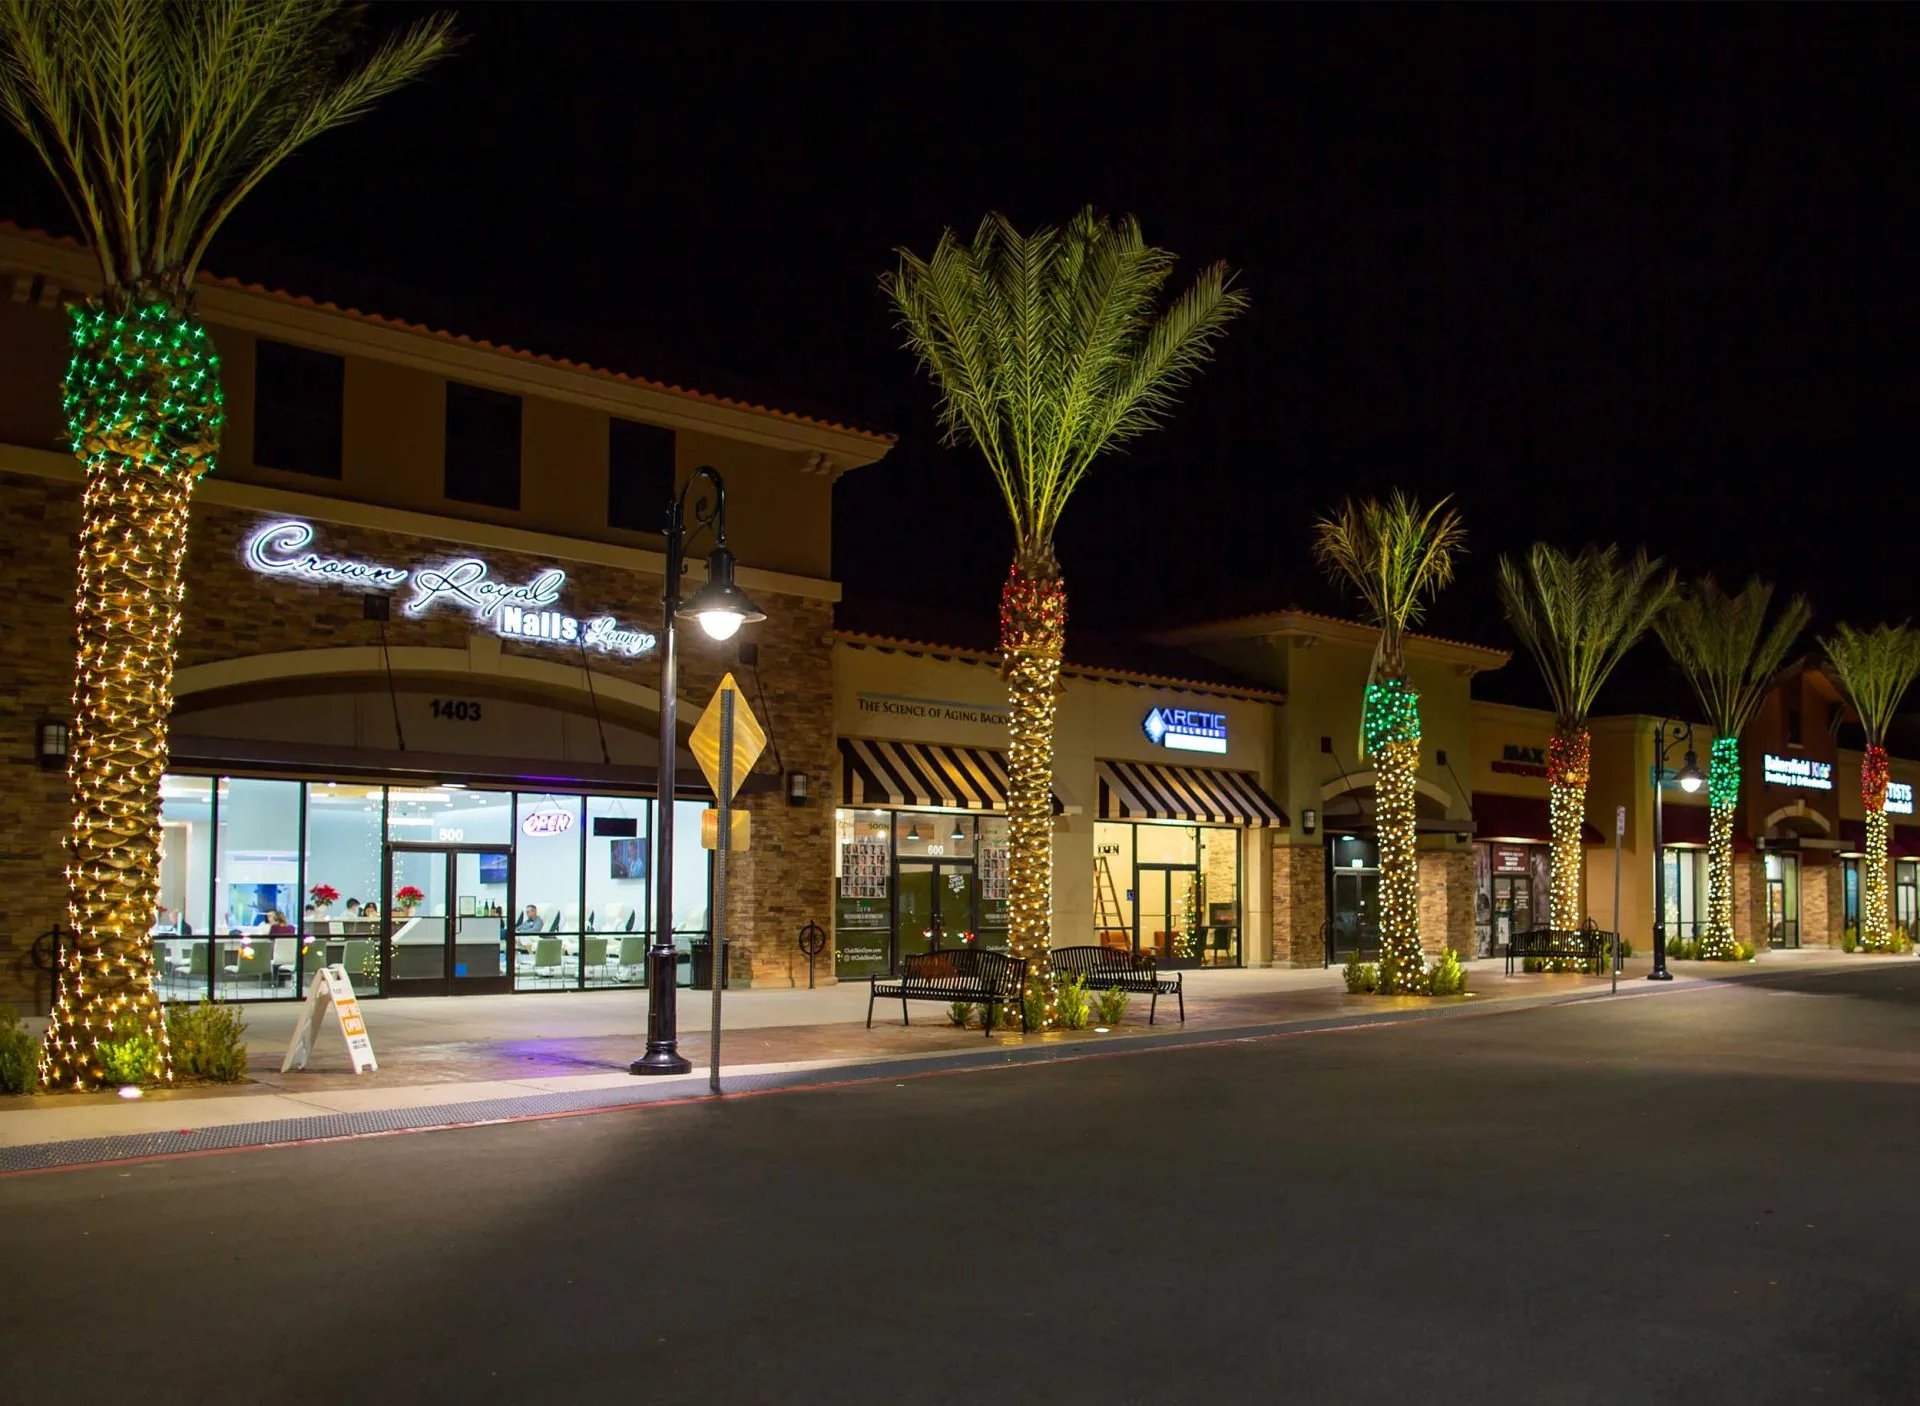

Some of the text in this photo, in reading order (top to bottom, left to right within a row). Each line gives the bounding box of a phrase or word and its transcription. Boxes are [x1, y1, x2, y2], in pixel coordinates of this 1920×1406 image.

[249, 521, 566, 618] Crown Royal
[503, 604, 657, 655] Nails Lounge
[430, 700, 482, 722] 1403
[858, 699, 880, 712] THE
[883, 703, 927, 717] SCIENCE
[928, 707, 942, 718] OF
[944, 709, 978, 722] AGING
[1162, 708, 1226, 730] ARCTIC
[1764, 754, 1810, 776] Bakersfield
[529, 812, 571, 833] OPEN
[868, 823, 890, 831] SOON
[439, 828, 464, 842] 500
[927, 844, 944, 855] 600
